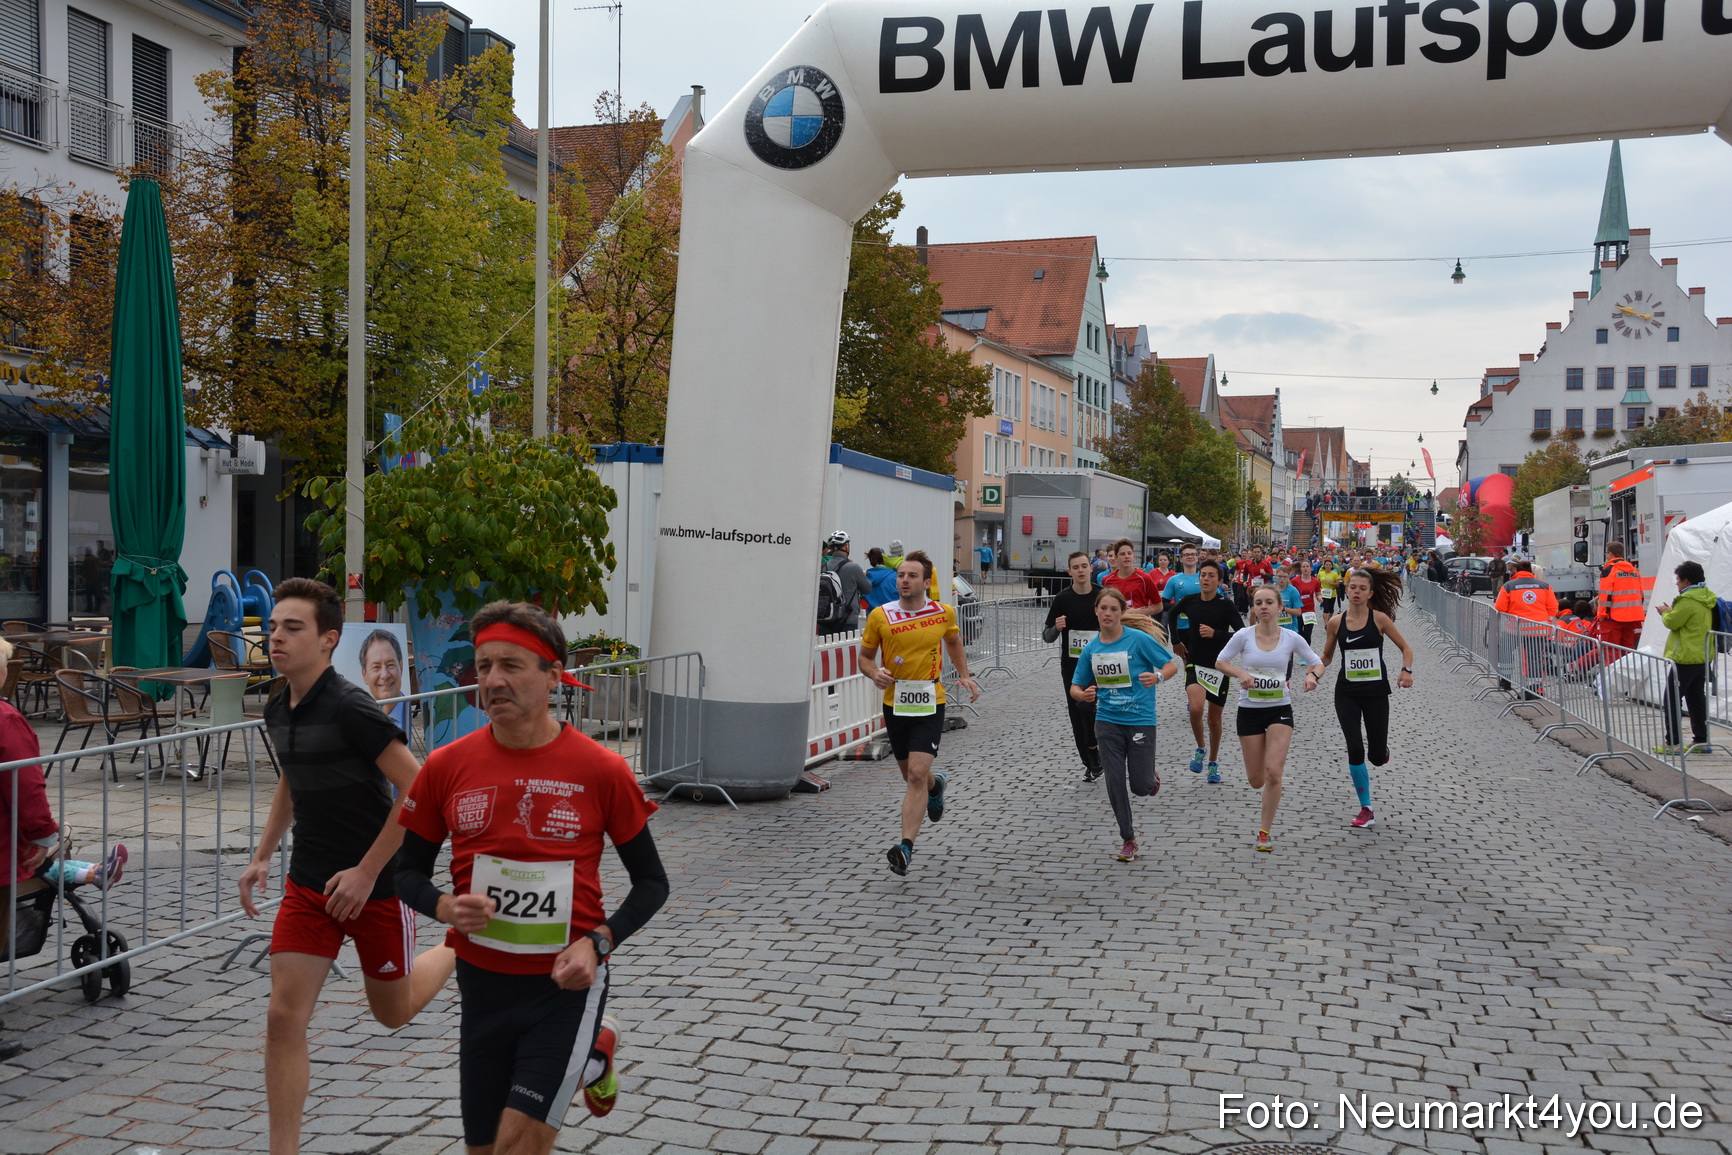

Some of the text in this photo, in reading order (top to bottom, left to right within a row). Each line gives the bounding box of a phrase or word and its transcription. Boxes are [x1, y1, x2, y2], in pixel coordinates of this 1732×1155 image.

[879, 3, 1154, 93] BMW
[759, 68, 836, 102] BMW
[985, 488, 999, 502] D
[1355, 513, 1373, 521] ZIEL
[659, 525, 792, 545] www.bmw-laufsport.de
[890, 616, 948, 636] MAX BÖGL
[1072, 638, 1088, 648] 513
[1097, 662, 1122, 676] 5091
[1350, 658, 1374, 670] 5001
[1254, 678, 1280, 689] 5000
[900, 692, 930, 704] 5008
[514, 779, 585, 793] 11. NEUMARKTER
[526, 786, 573, 798] STADTLAUF
[457, 801, 488, 813] WIEDER
[458, 794, 488, 806] IMMER
[458, 809, 485, 824] NEU
[486, 886, 557, 918] 5224
